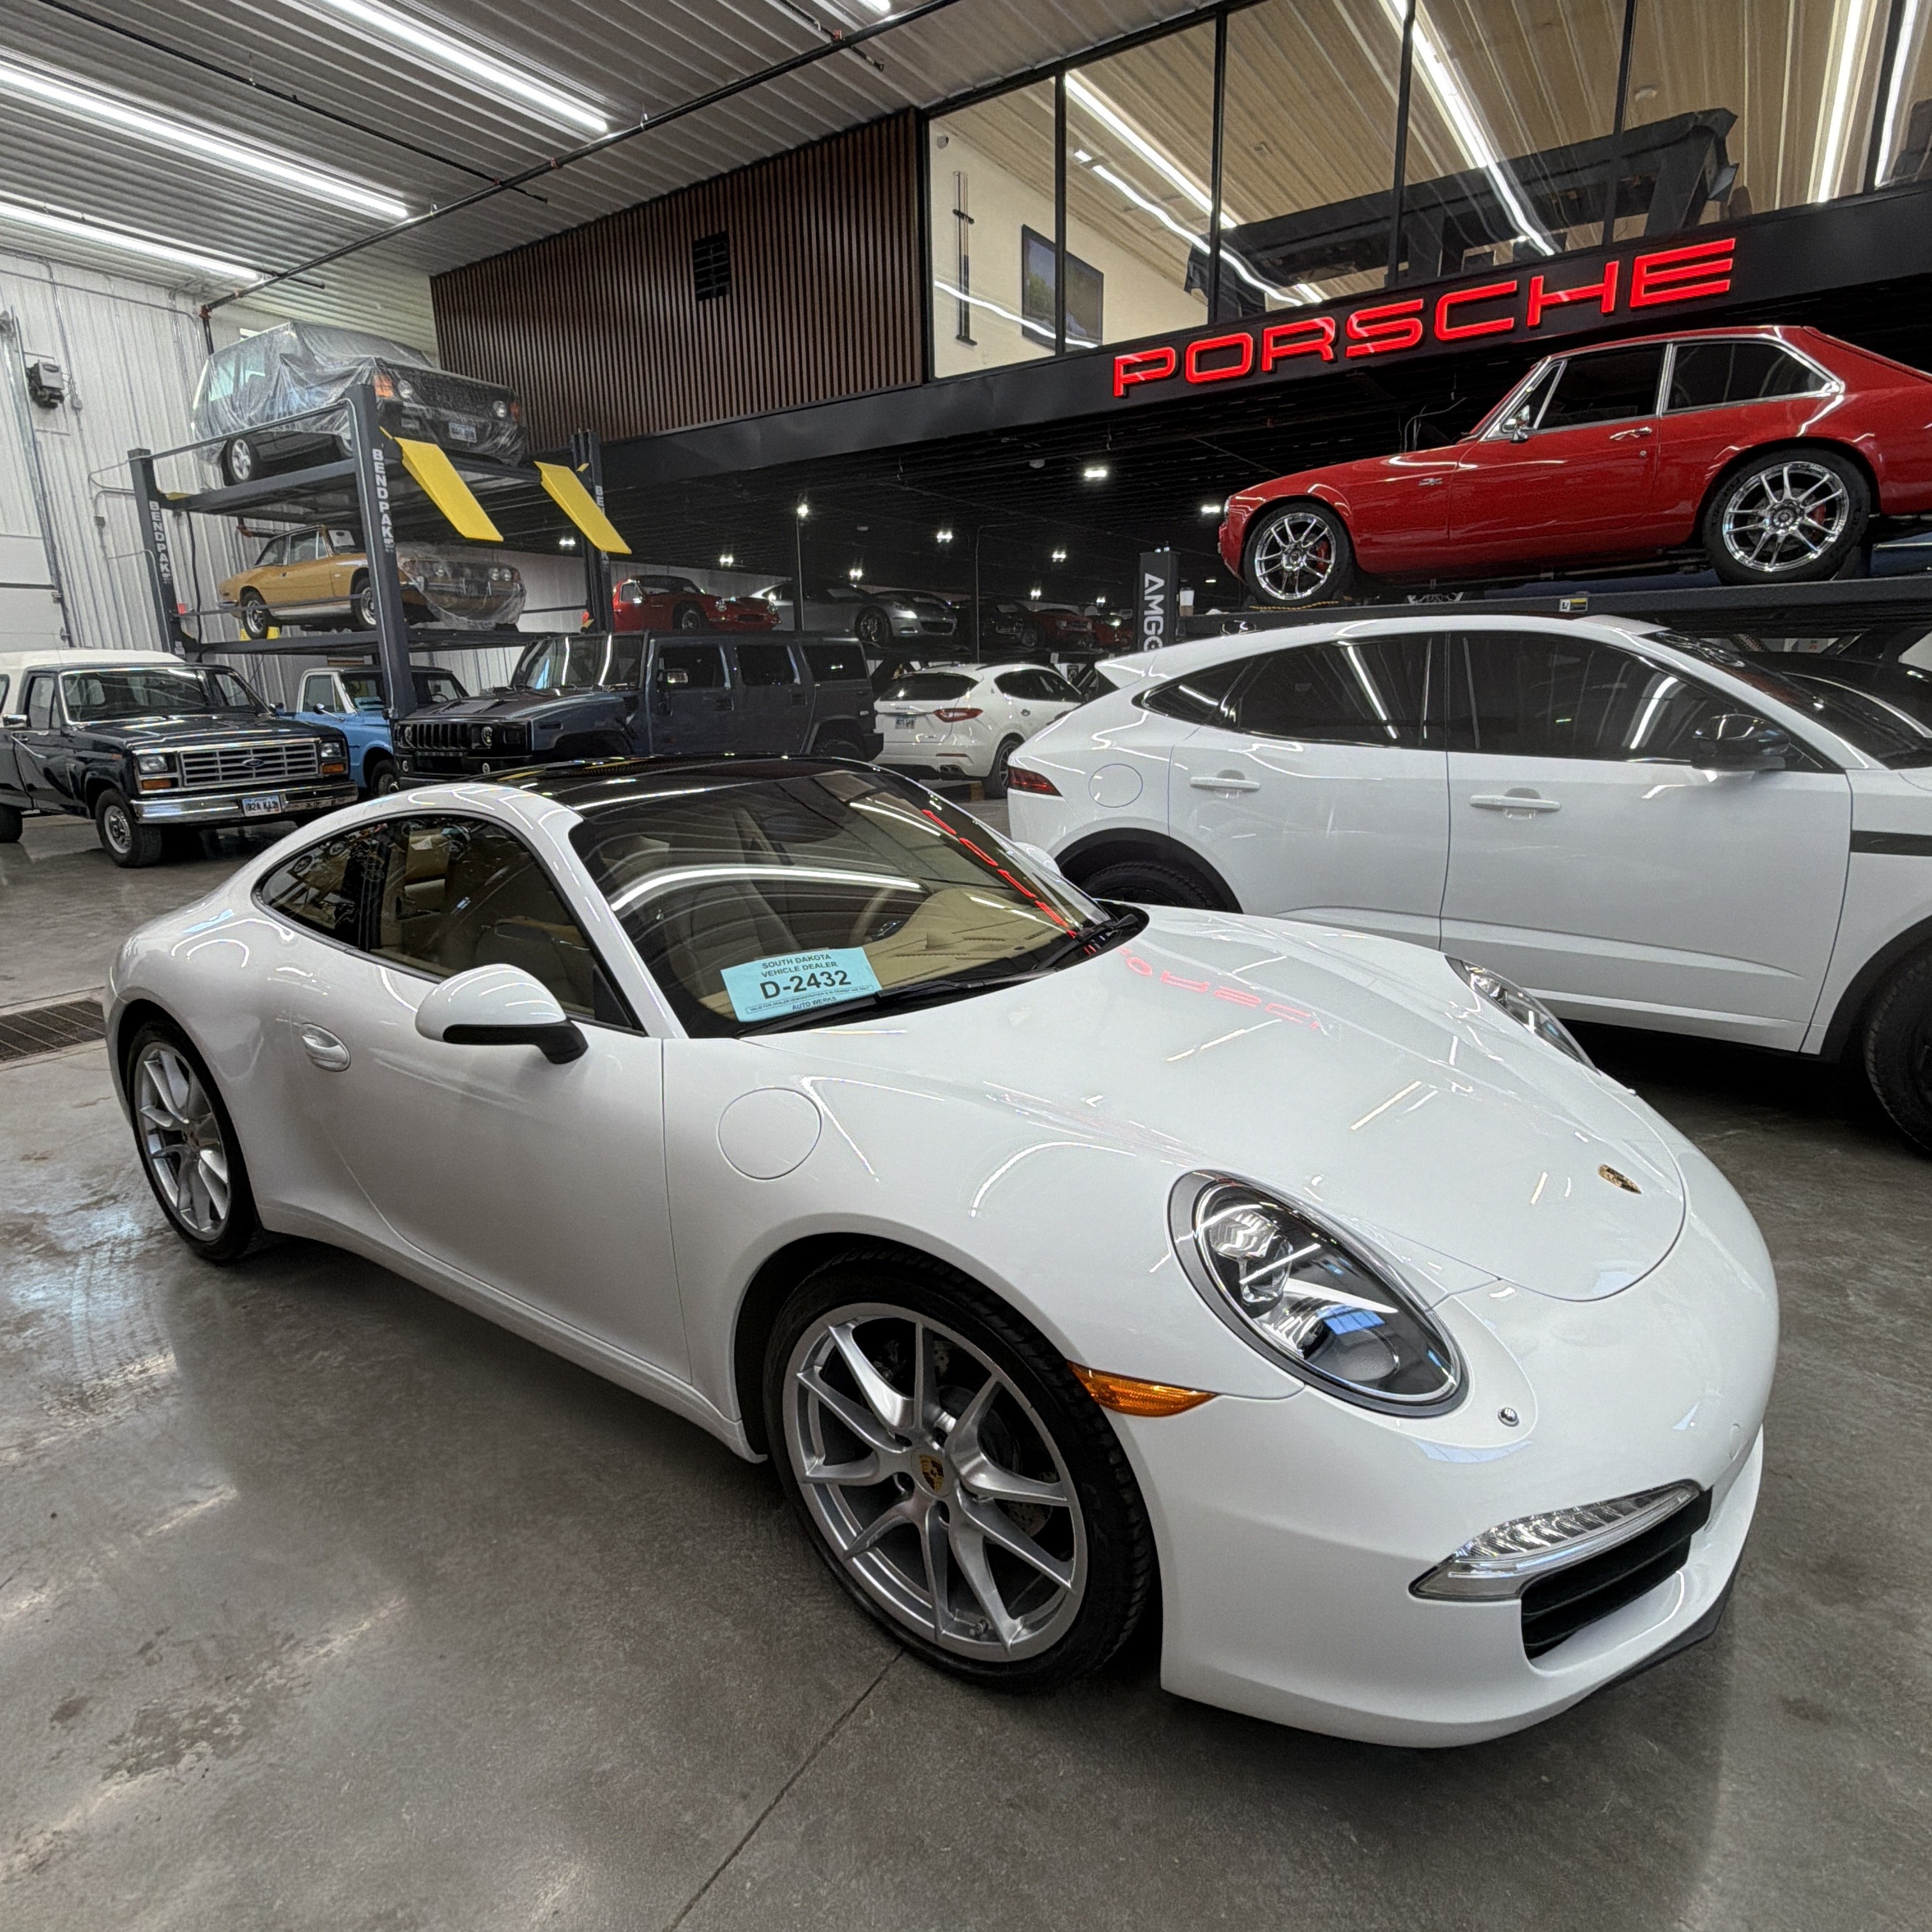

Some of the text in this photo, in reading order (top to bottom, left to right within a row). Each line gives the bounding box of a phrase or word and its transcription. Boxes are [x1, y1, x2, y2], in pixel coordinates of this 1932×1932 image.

[1112, 238, 1736, 399] PORSCHE
[372, 448, 394, 538] BENDPAK
[149, 500, 170, 572] BENDPAK
[761, 961, 838, 977] VEHICLE DEALER
[762, 953, 832, 969] SOUTH DAKOTA
[760, 970, 852, 999] D-2432
[792, 996, 837, 1010] AUTO WERKS
